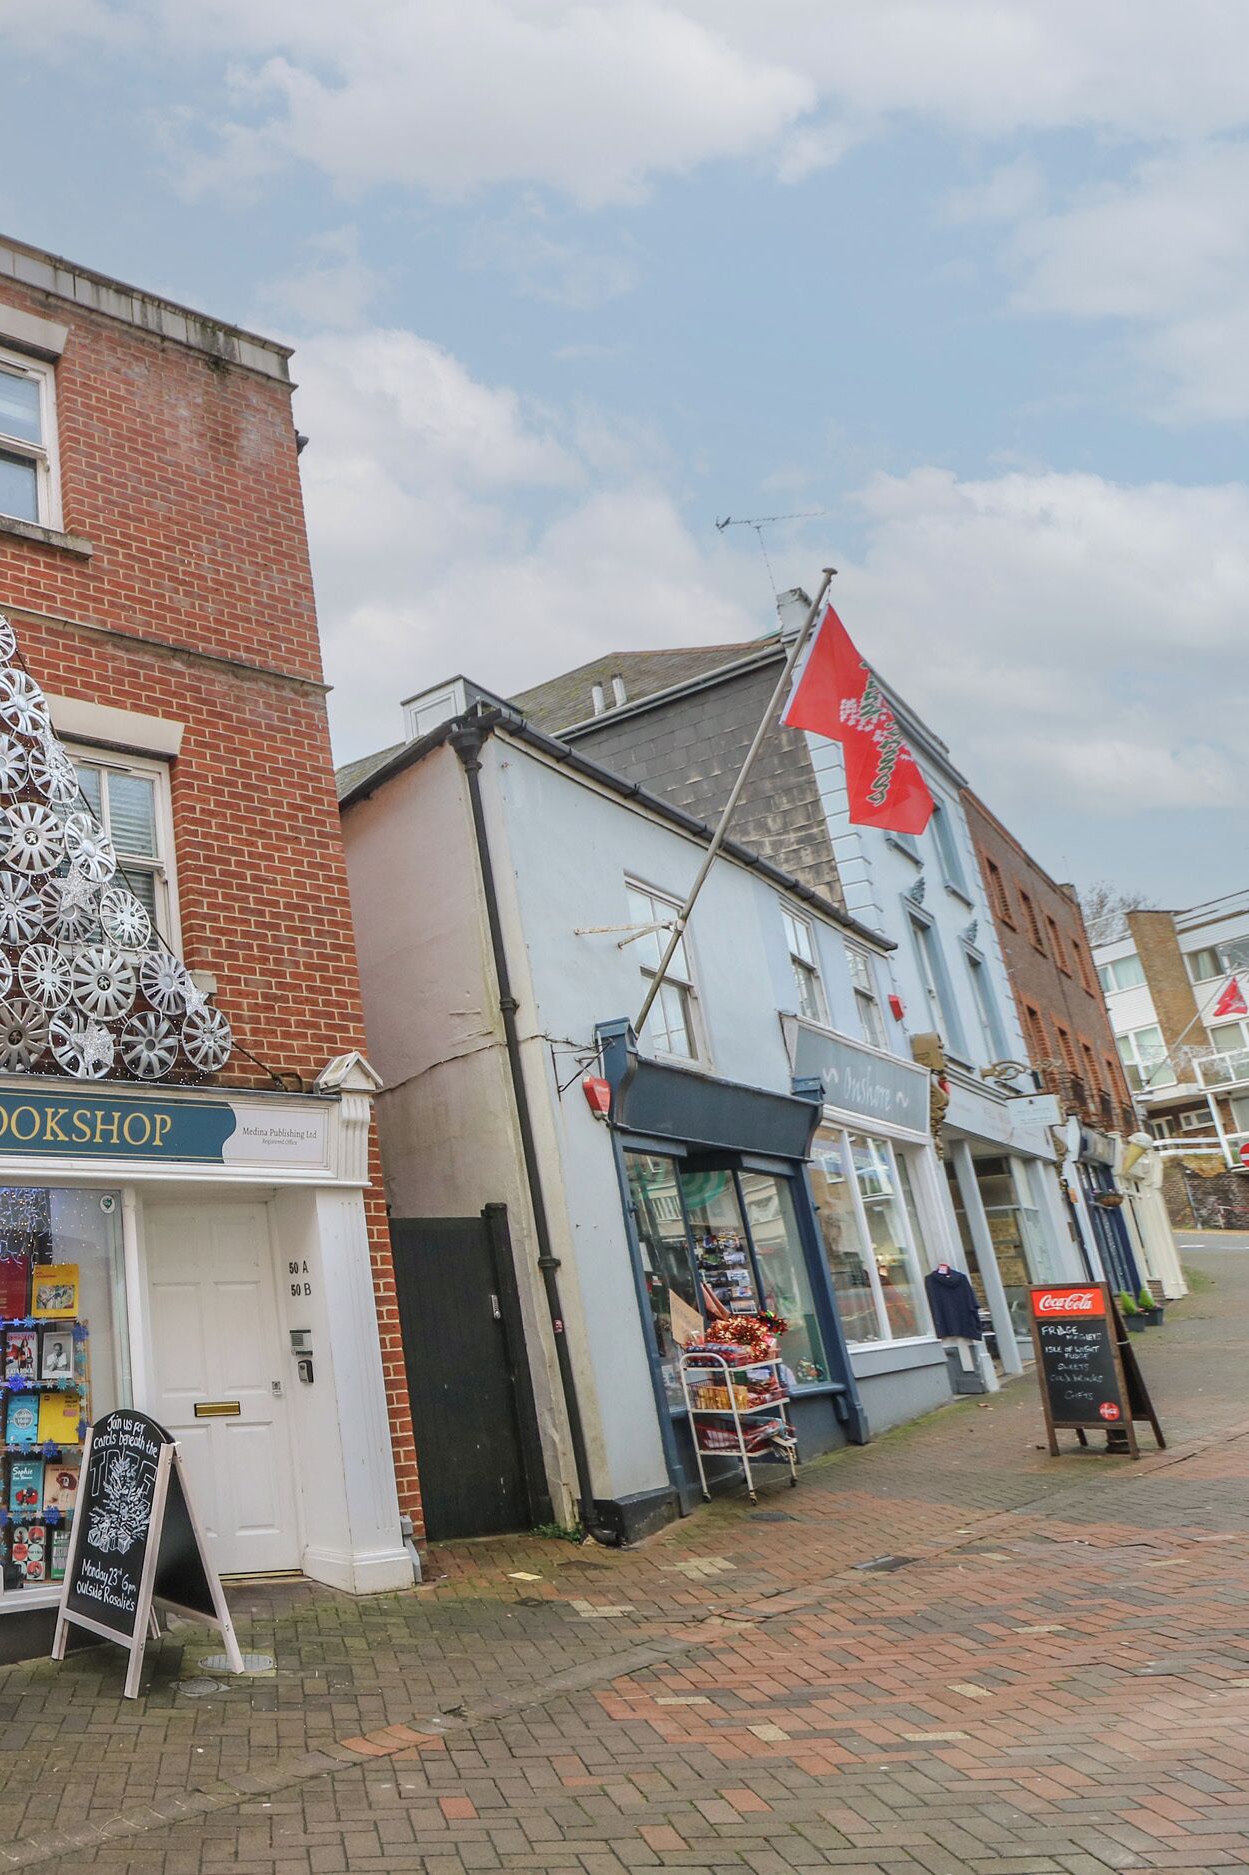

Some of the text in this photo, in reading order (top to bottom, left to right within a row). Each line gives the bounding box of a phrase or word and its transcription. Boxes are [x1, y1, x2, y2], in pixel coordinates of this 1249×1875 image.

[242, 1127, 317, 1140] Medina Publishing Ltd
[289, 1260, 309, 1275] 50 A
[291, 1282, 312, 1297] 50 B
[1038, 1292, 1095, 1312] Coca-Cola
[106, 1413, 146, 1435] Join us for
[93, 1431, 158, 1458] carols beneath the
[12, 1467, 33, 1477] Sophie
[81, 1558, 109, 1589] Monday
[107, 1567, 123, 1586] 23rd
[121, 1573, 137, 1595] 6pm
[76, 1580, 136, 1612] outside Rosalie's
